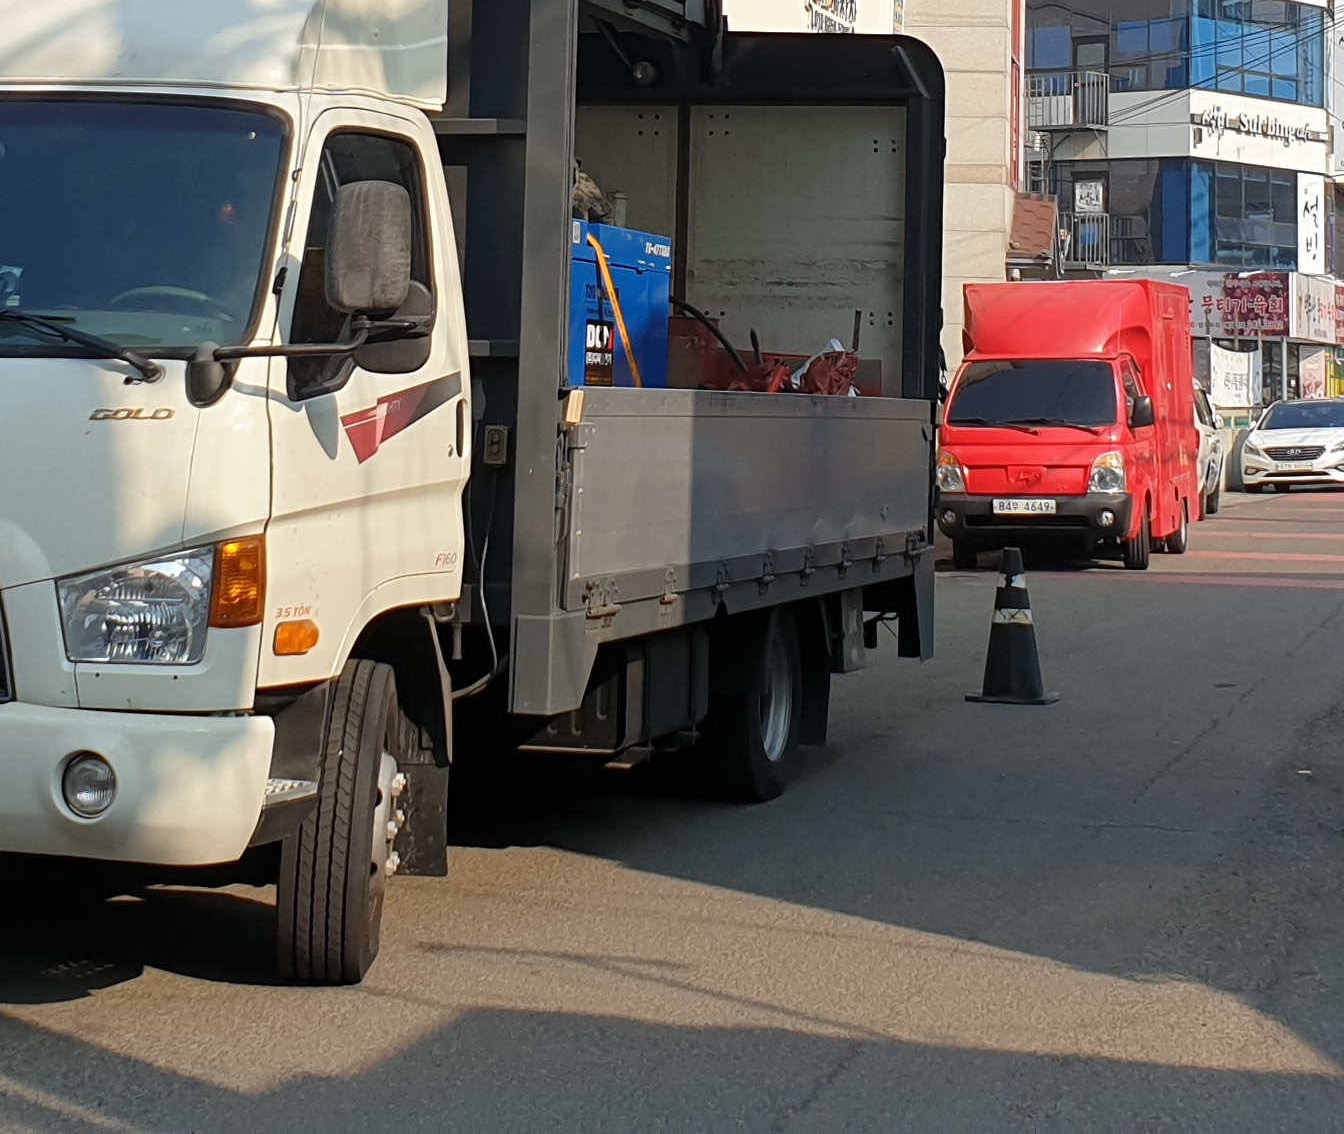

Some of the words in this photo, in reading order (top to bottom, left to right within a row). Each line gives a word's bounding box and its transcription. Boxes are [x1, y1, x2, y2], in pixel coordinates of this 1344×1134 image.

[88, 408, 175, 421] GOLD
[1023, 500, 1051, 512] 4649
[434, 552, 457, 566] F160
[293, 605, 312, 617] TON
